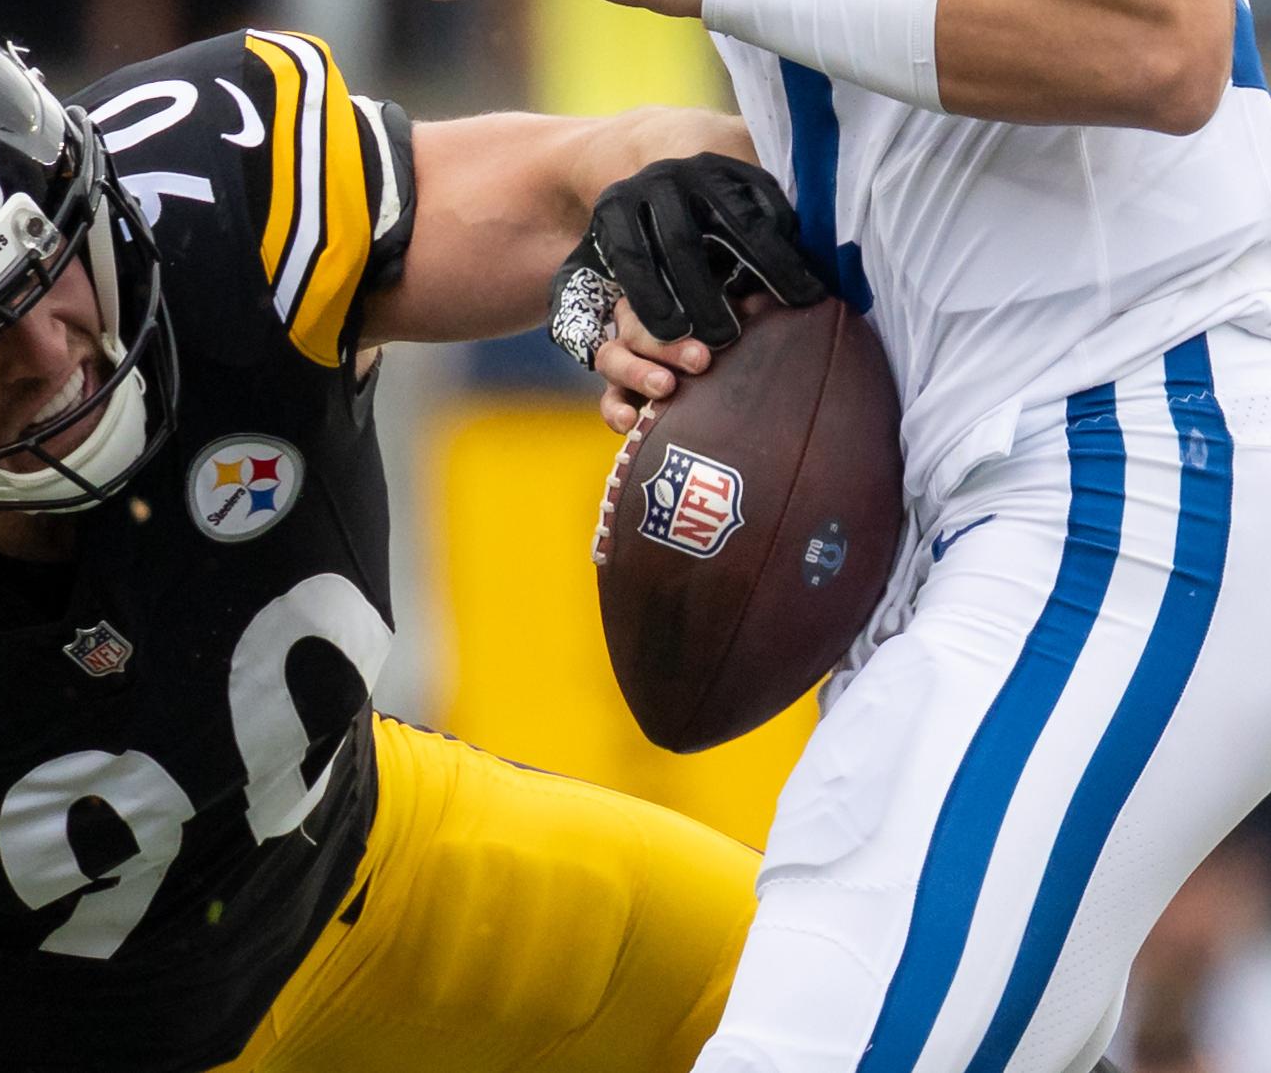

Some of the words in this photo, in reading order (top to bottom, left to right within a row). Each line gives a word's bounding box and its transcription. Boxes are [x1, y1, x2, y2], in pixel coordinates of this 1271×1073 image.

[206, 487, 247, 527] Steelers
[672, 474, 731, 549] NFL
[805, 538, 825, 564] 070
[84, 640, 122, 671] NFL
